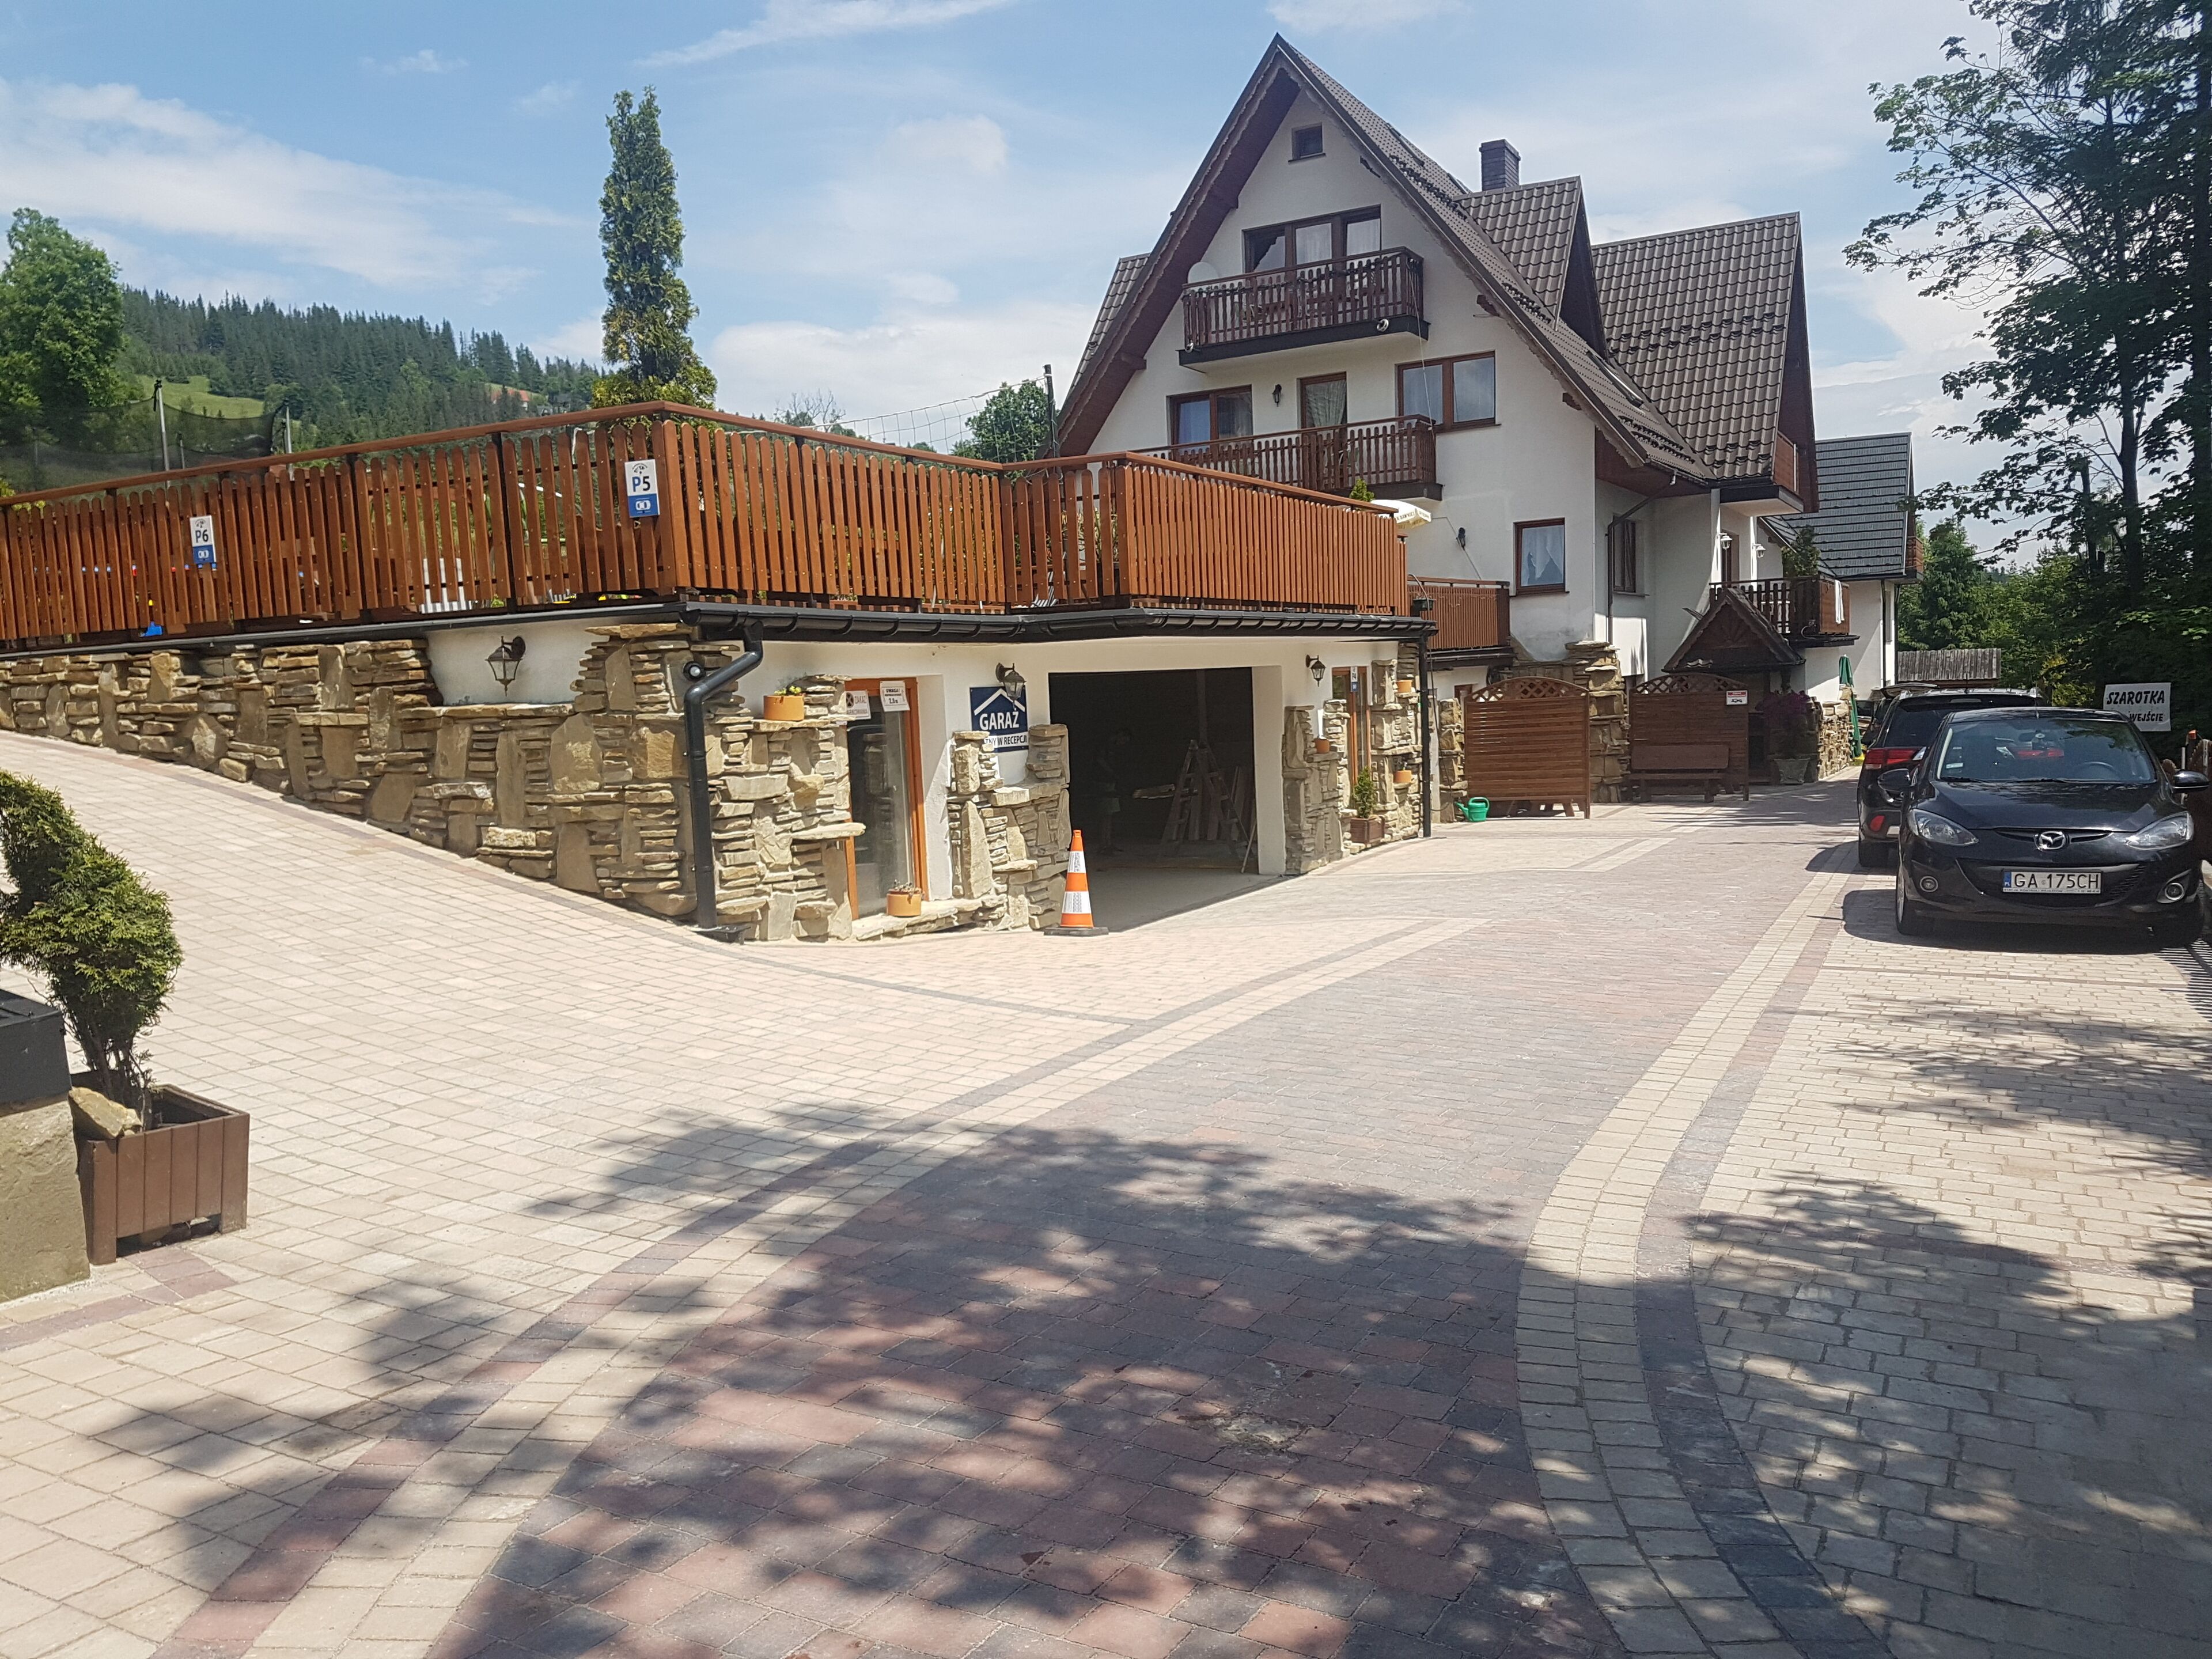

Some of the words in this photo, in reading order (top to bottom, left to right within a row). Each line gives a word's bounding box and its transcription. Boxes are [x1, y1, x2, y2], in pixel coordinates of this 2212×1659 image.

[631, 476, 651, 492] P5
[195, 529, 209, 543] P6
[2106, 690, 2165, 705] SZAROTKA
[979, 707, 1020, 731] GARAŻ
[2129, 711, 2164, 722] WEJŚCIE
[997, 737, 1003, 745] W
[1004, 735, 1028, 745] RECEPCJI
[2014, 873, 2038, 888] GA
[2047, 873, 2099, 889] 175CH
